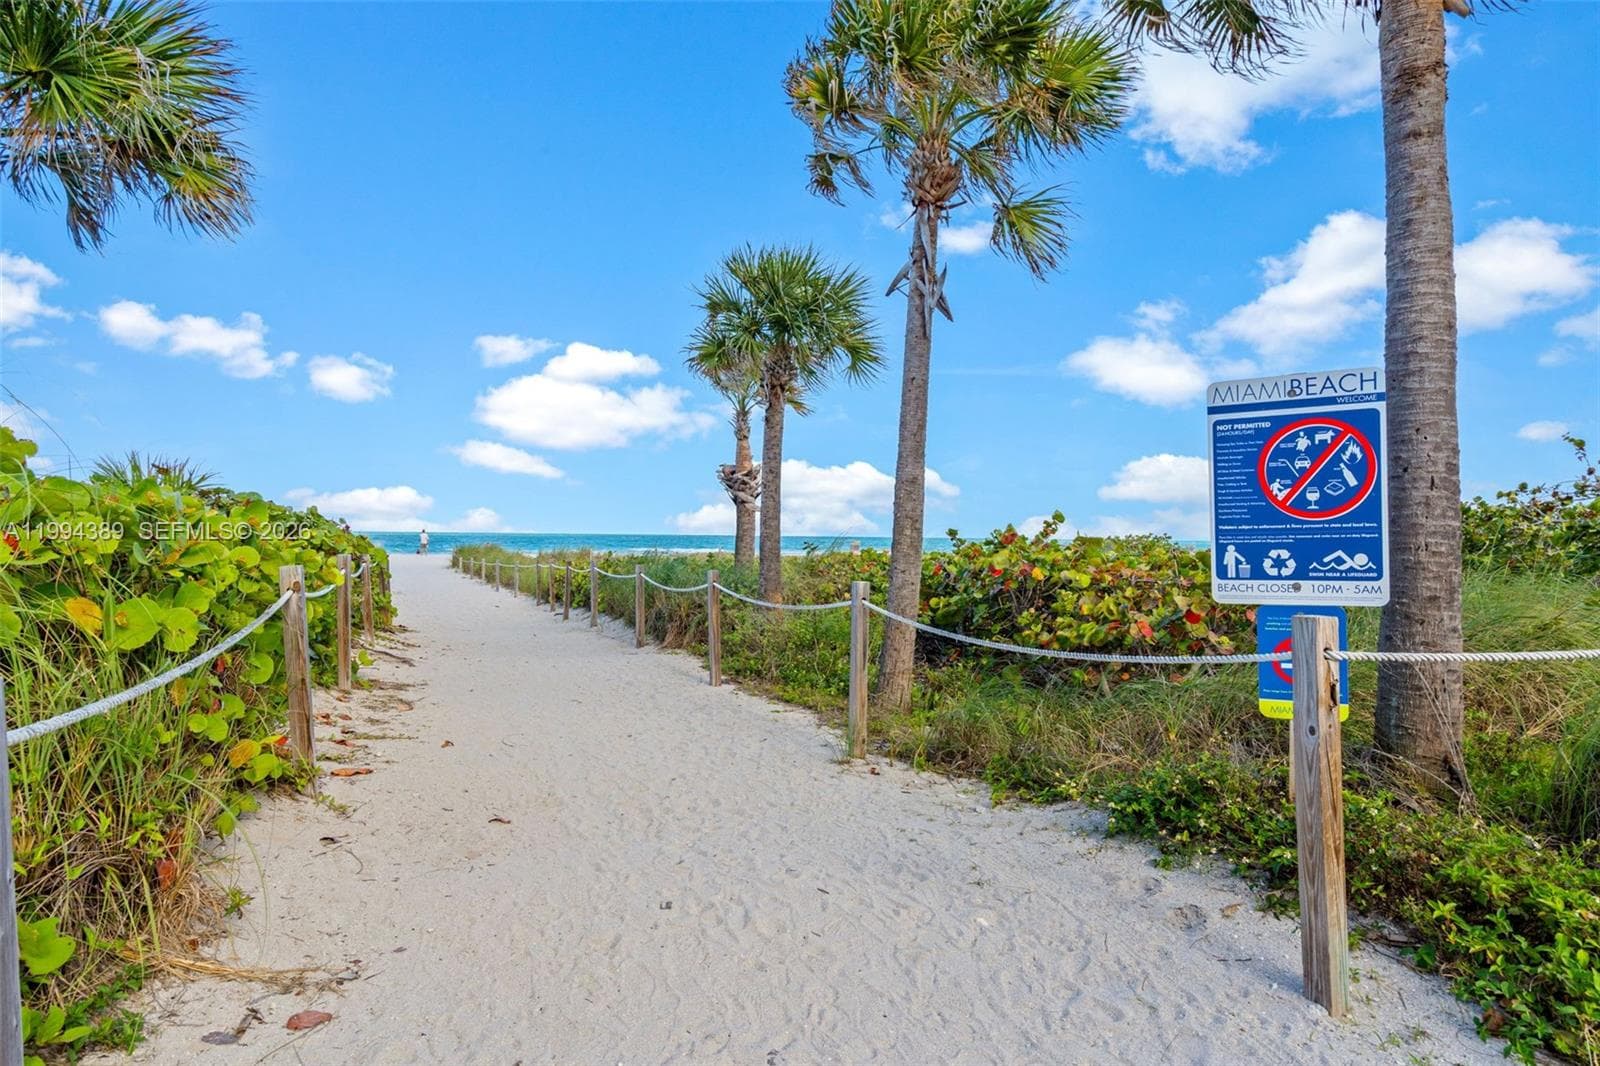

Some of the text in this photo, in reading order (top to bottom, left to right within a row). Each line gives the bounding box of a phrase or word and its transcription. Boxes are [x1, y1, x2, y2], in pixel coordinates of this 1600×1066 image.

[1336, 394, 1378, 403] WELCOME
[1233, 421, 1271, 430] PERMITTED
[1217, 583, 1254, 593] BEACH
[1257, 584, 1301, 593] CLOSE
[1311, 584, 1344, 593] 10PM
[1354, 584, 1383, 594] 5AM
